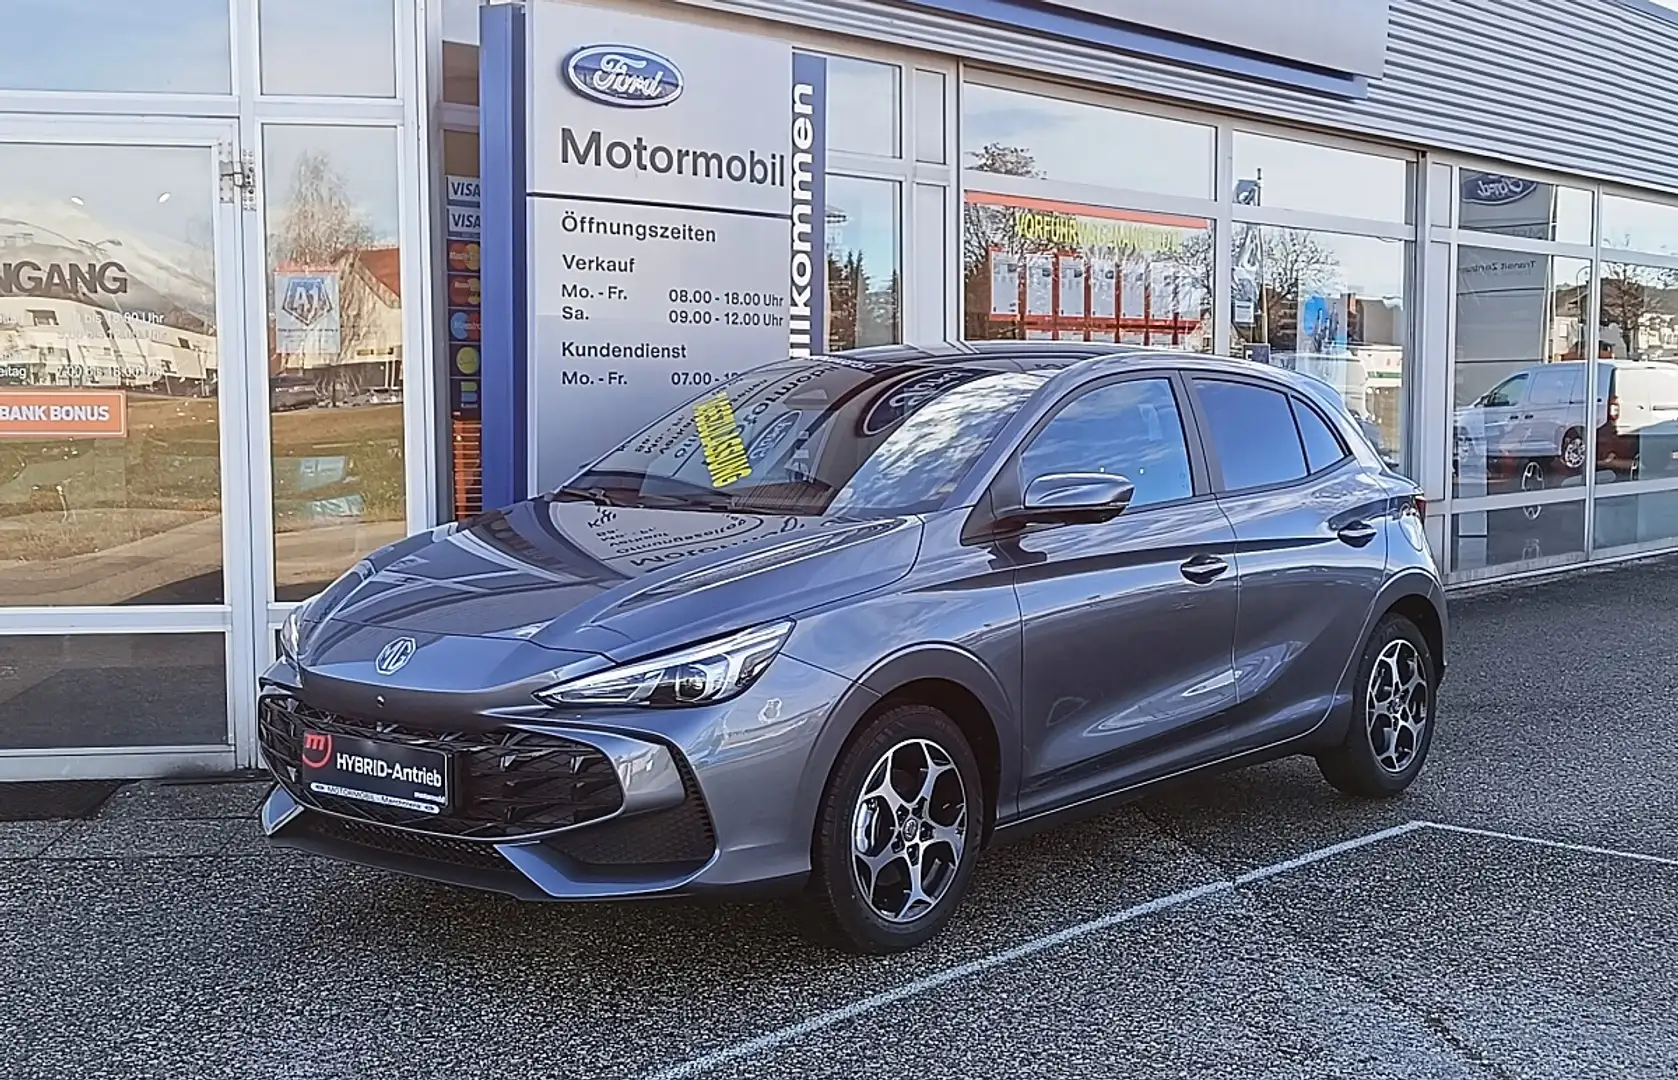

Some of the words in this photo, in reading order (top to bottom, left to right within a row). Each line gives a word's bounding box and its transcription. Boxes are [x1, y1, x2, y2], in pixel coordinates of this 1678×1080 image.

[593, 54, 665, 98] Ford
[561, 127, 785, 187] Motormobil
[451, 182, 480, 197] VISA
[452, 213, 480, 228] VISA
[561, 211, 716, 242] Öffnungszeiten
[562, 254, 635, 273] Verkauf
[562, 284, 594, 299] Mo.
[608, 286, 628, 300] Fr.
[669, 289, 712, 304] 08.00
[724, 292, 760, 306] 18.00
[763, 294, 783, 307] Uhr
[142, 312, 165, 323] Uhr
[562, 306, 589, 320] Sa.
[669, 310, 712, 324] 09.00
[724, 312, 760, 326] 12.00
[763, 313, 783, 327] Uhr
[562, 342, 687, 359] Kundendienst
[562, 371, 594, 385] Mo.
[608, 372, 628, 385] Fr.
[671, 372, 712, 385] 07.00
[0, 406, 47, 421] BANK
[51, 406, 109, 421] BONUS
[378, 638, 415, 672] MG
[336, 752, 442, 788] HYBRID-Antrieb
